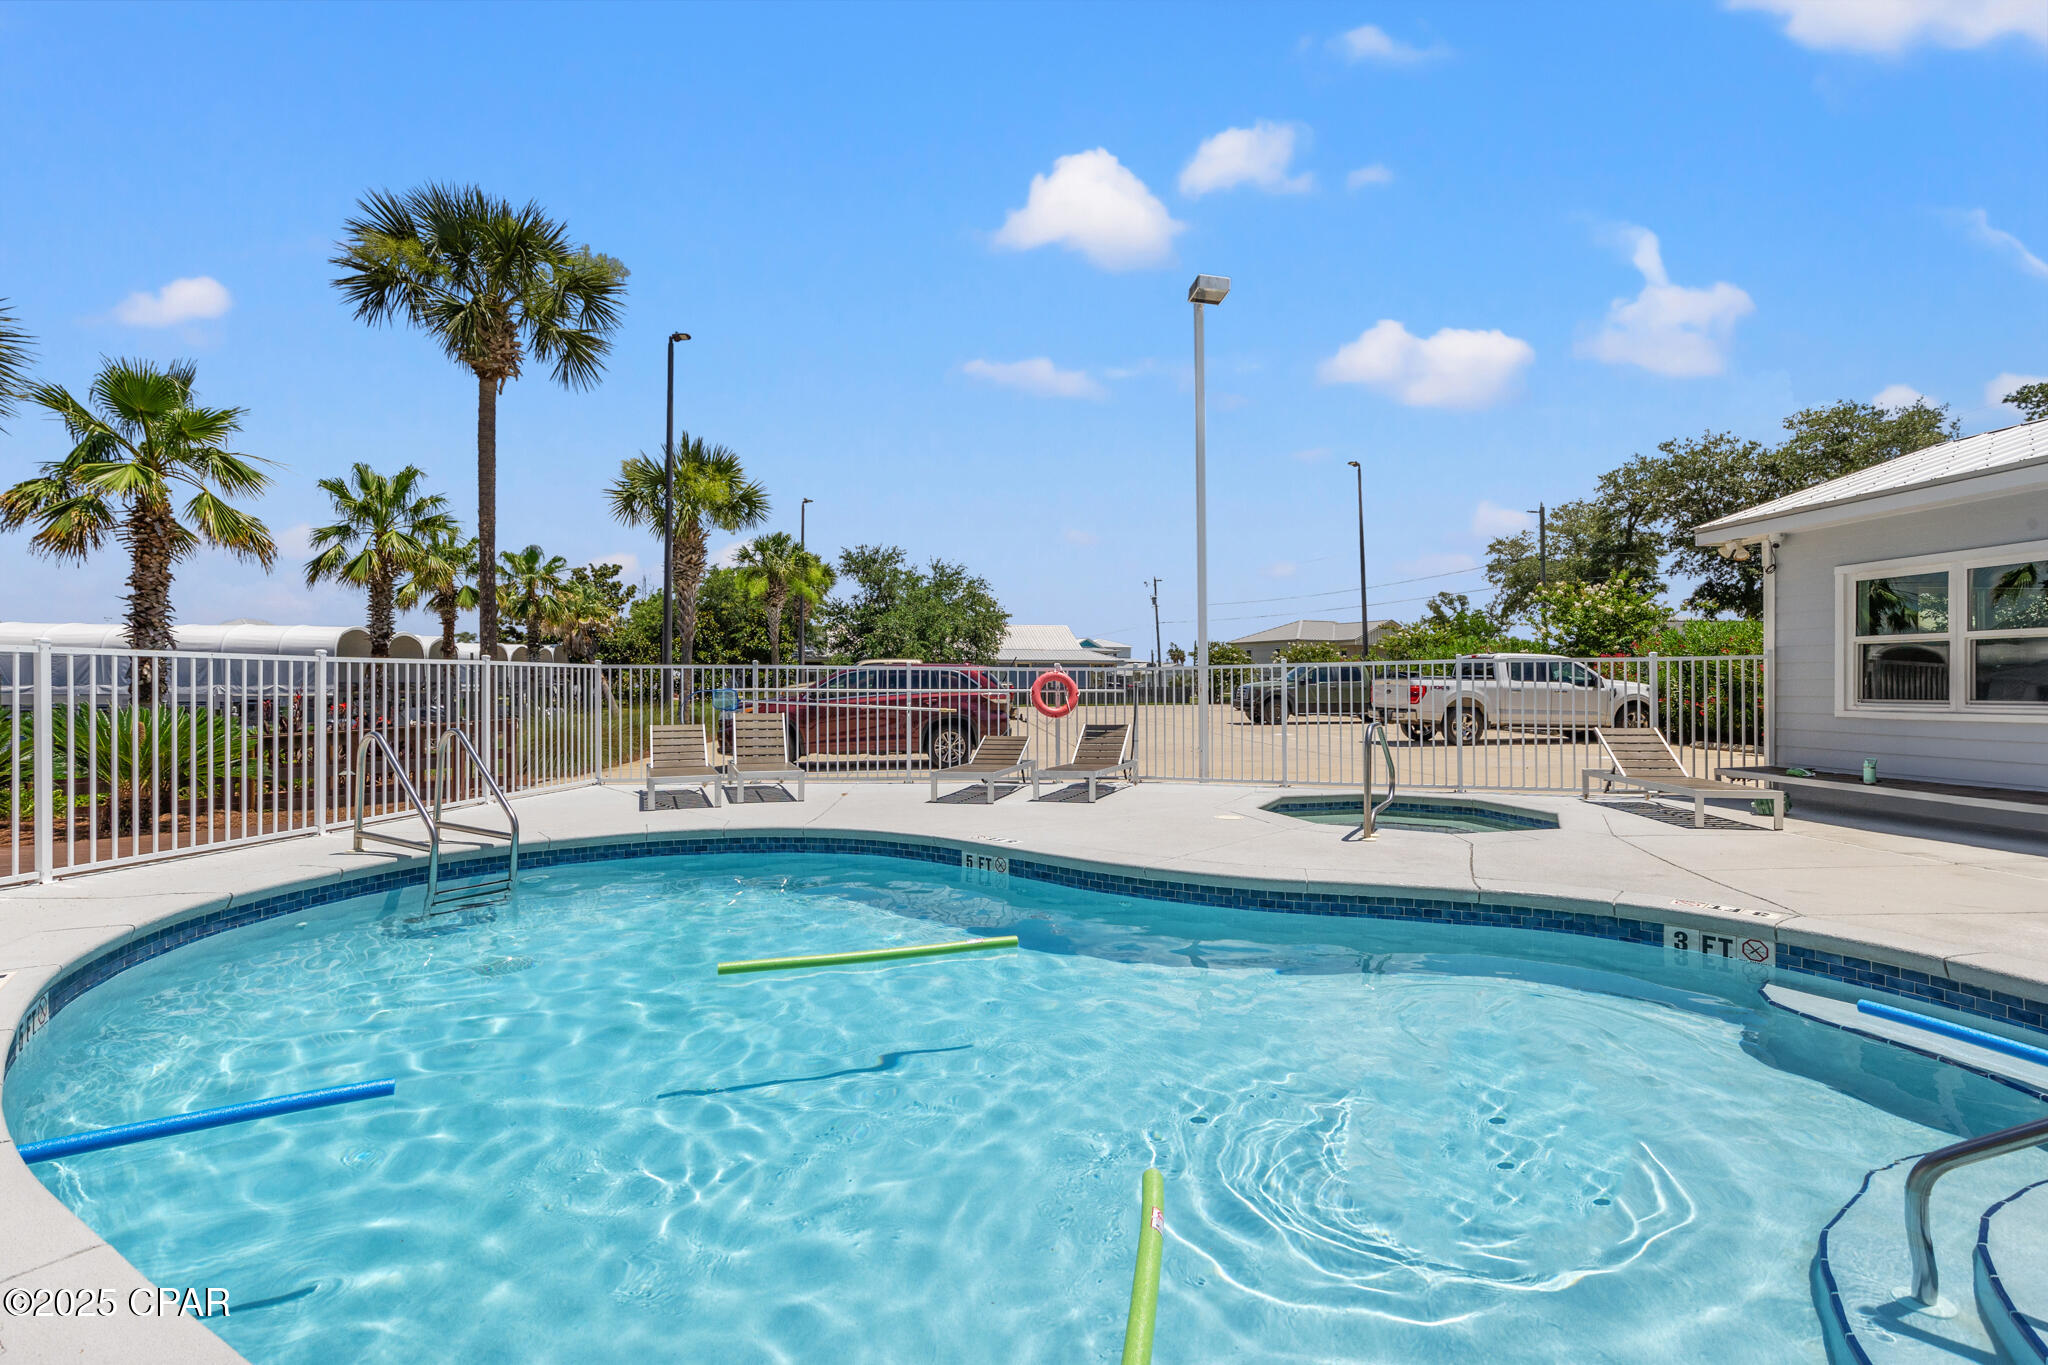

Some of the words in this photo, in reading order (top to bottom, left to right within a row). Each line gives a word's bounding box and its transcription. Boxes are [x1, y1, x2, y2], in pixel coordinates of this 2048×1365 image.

[966, 854, 973, 868] 5
[978, 855, 992, 871] FT
[1673, 930, 1688, 950] 3
